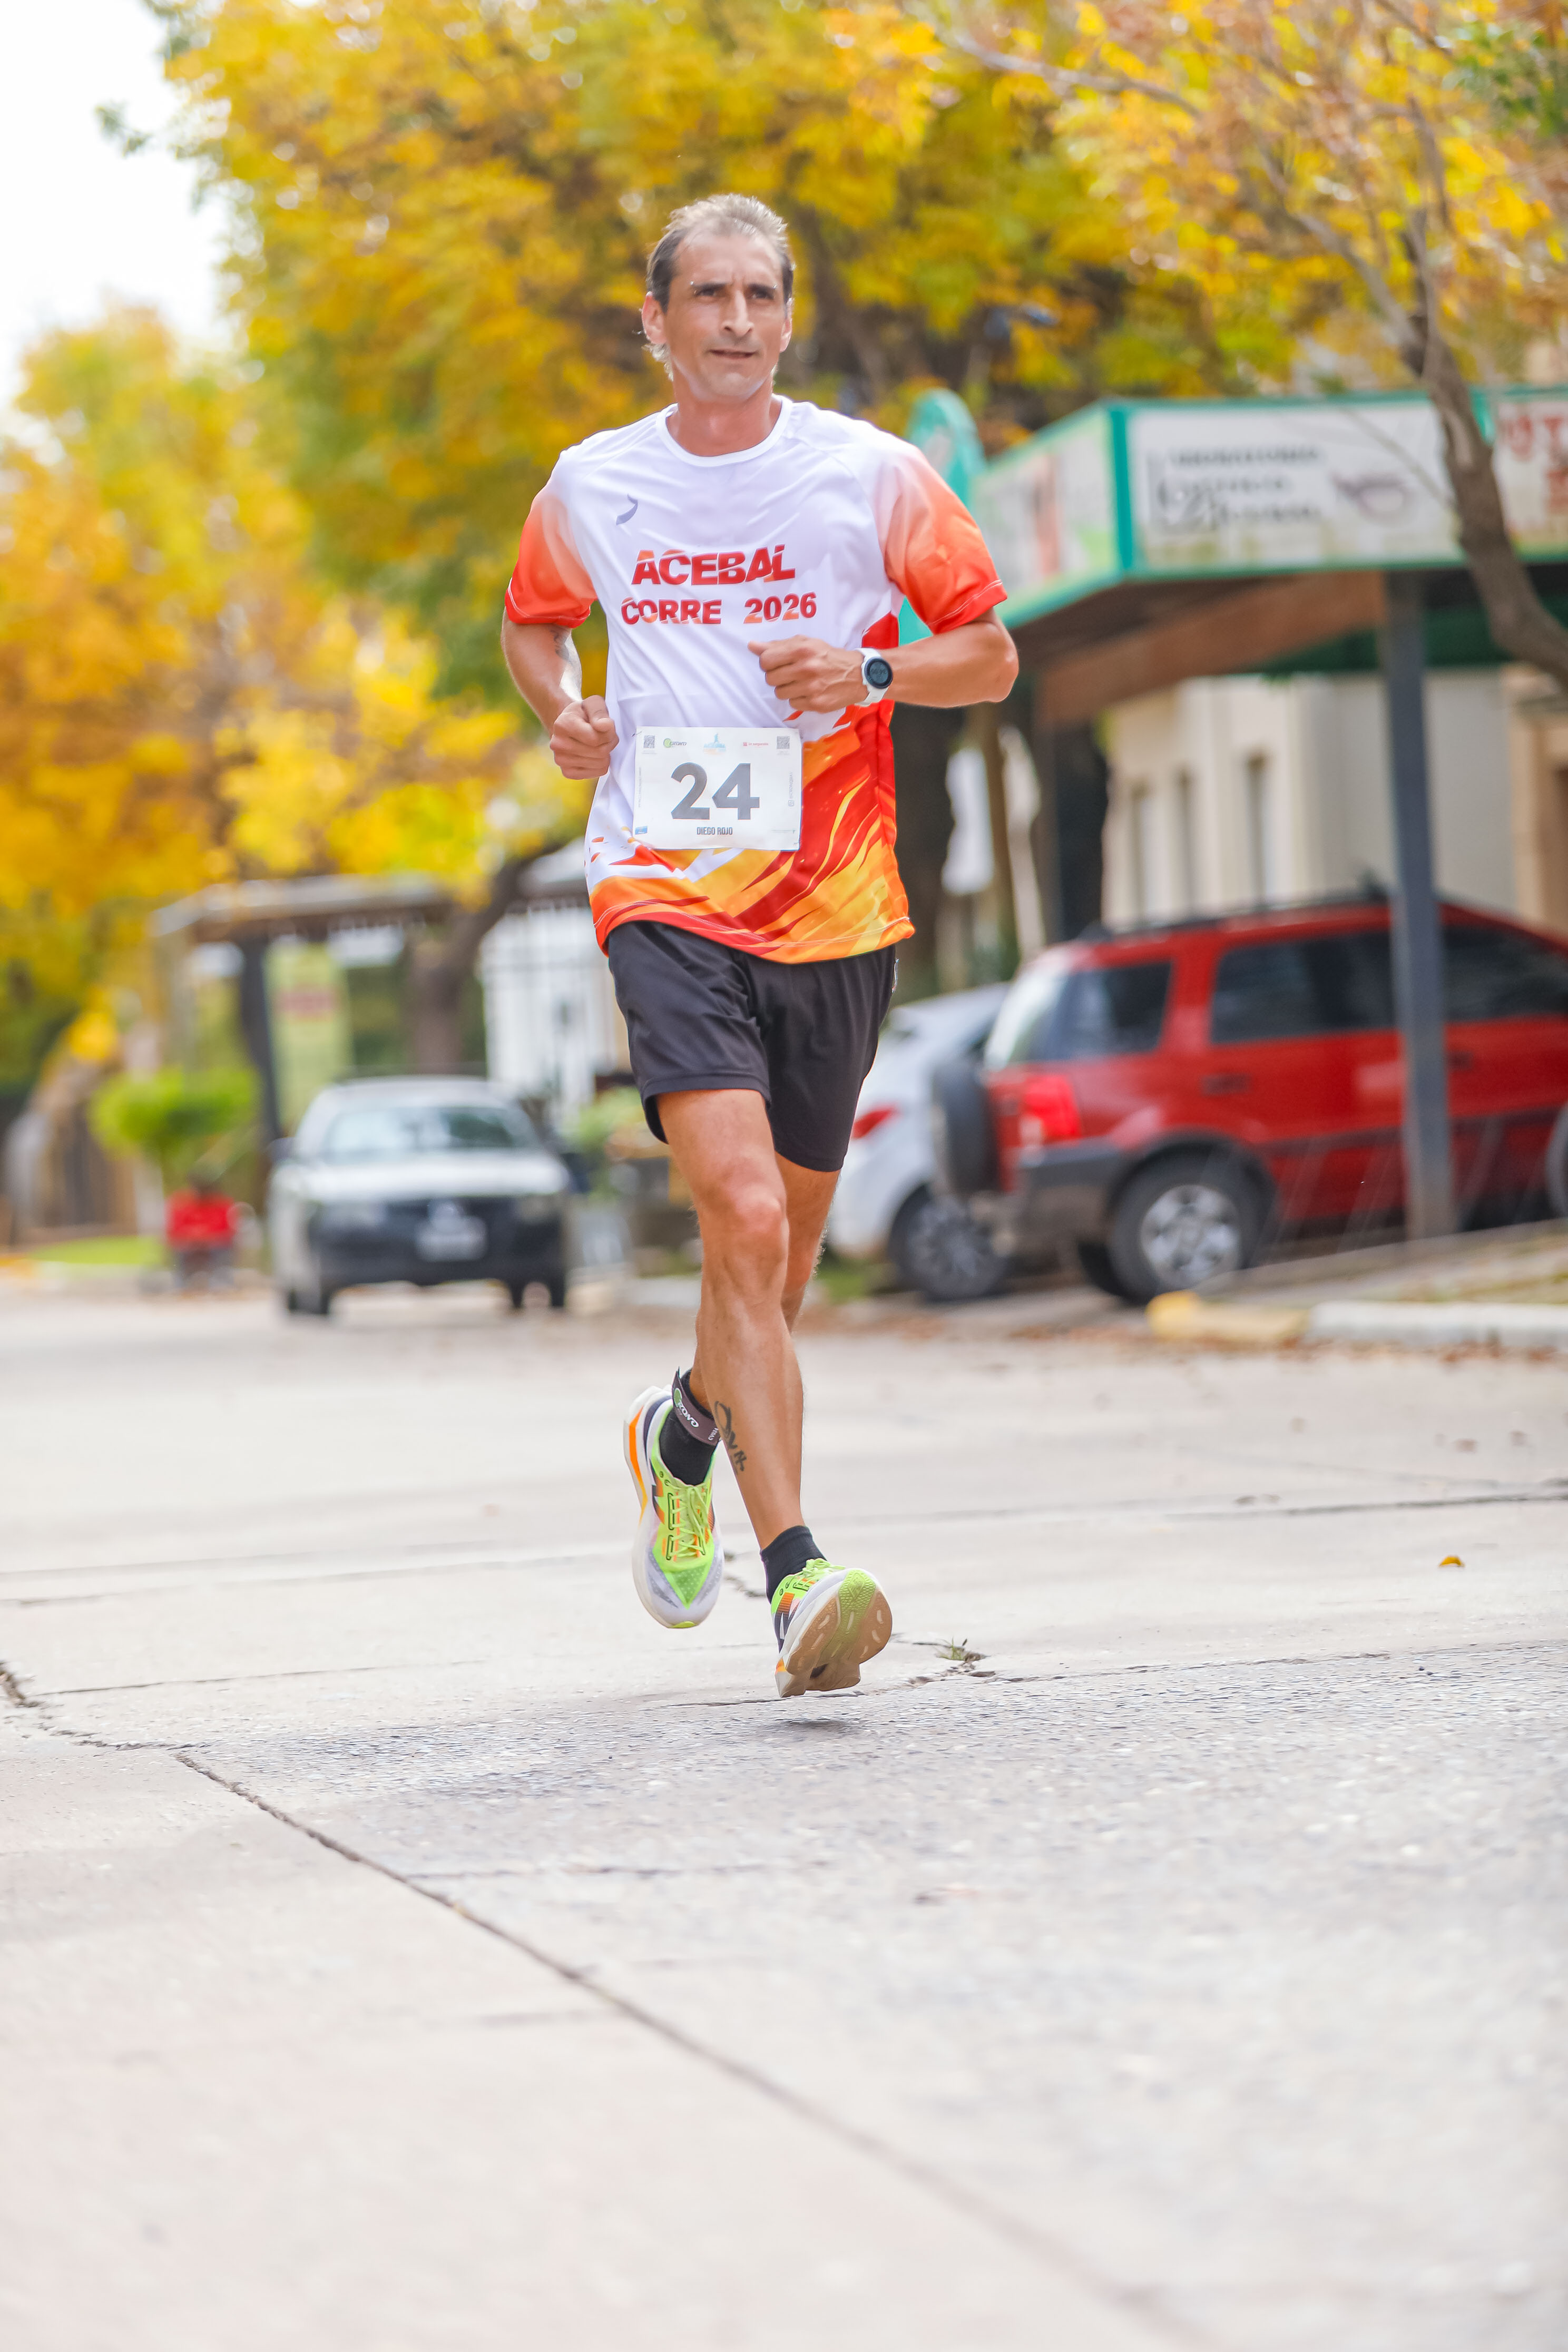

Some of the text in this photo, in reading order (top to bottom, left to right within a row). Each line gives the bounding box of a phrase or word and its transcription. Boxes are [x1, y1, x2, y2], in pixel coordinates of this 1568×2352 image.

[631, 544, 795, 585] ACEBAL
[621, 592, 817, 625] CORRE 2026
[671, 762, 760, 820] 24
[697, 827, 733, 835] DIEGO ROJO
